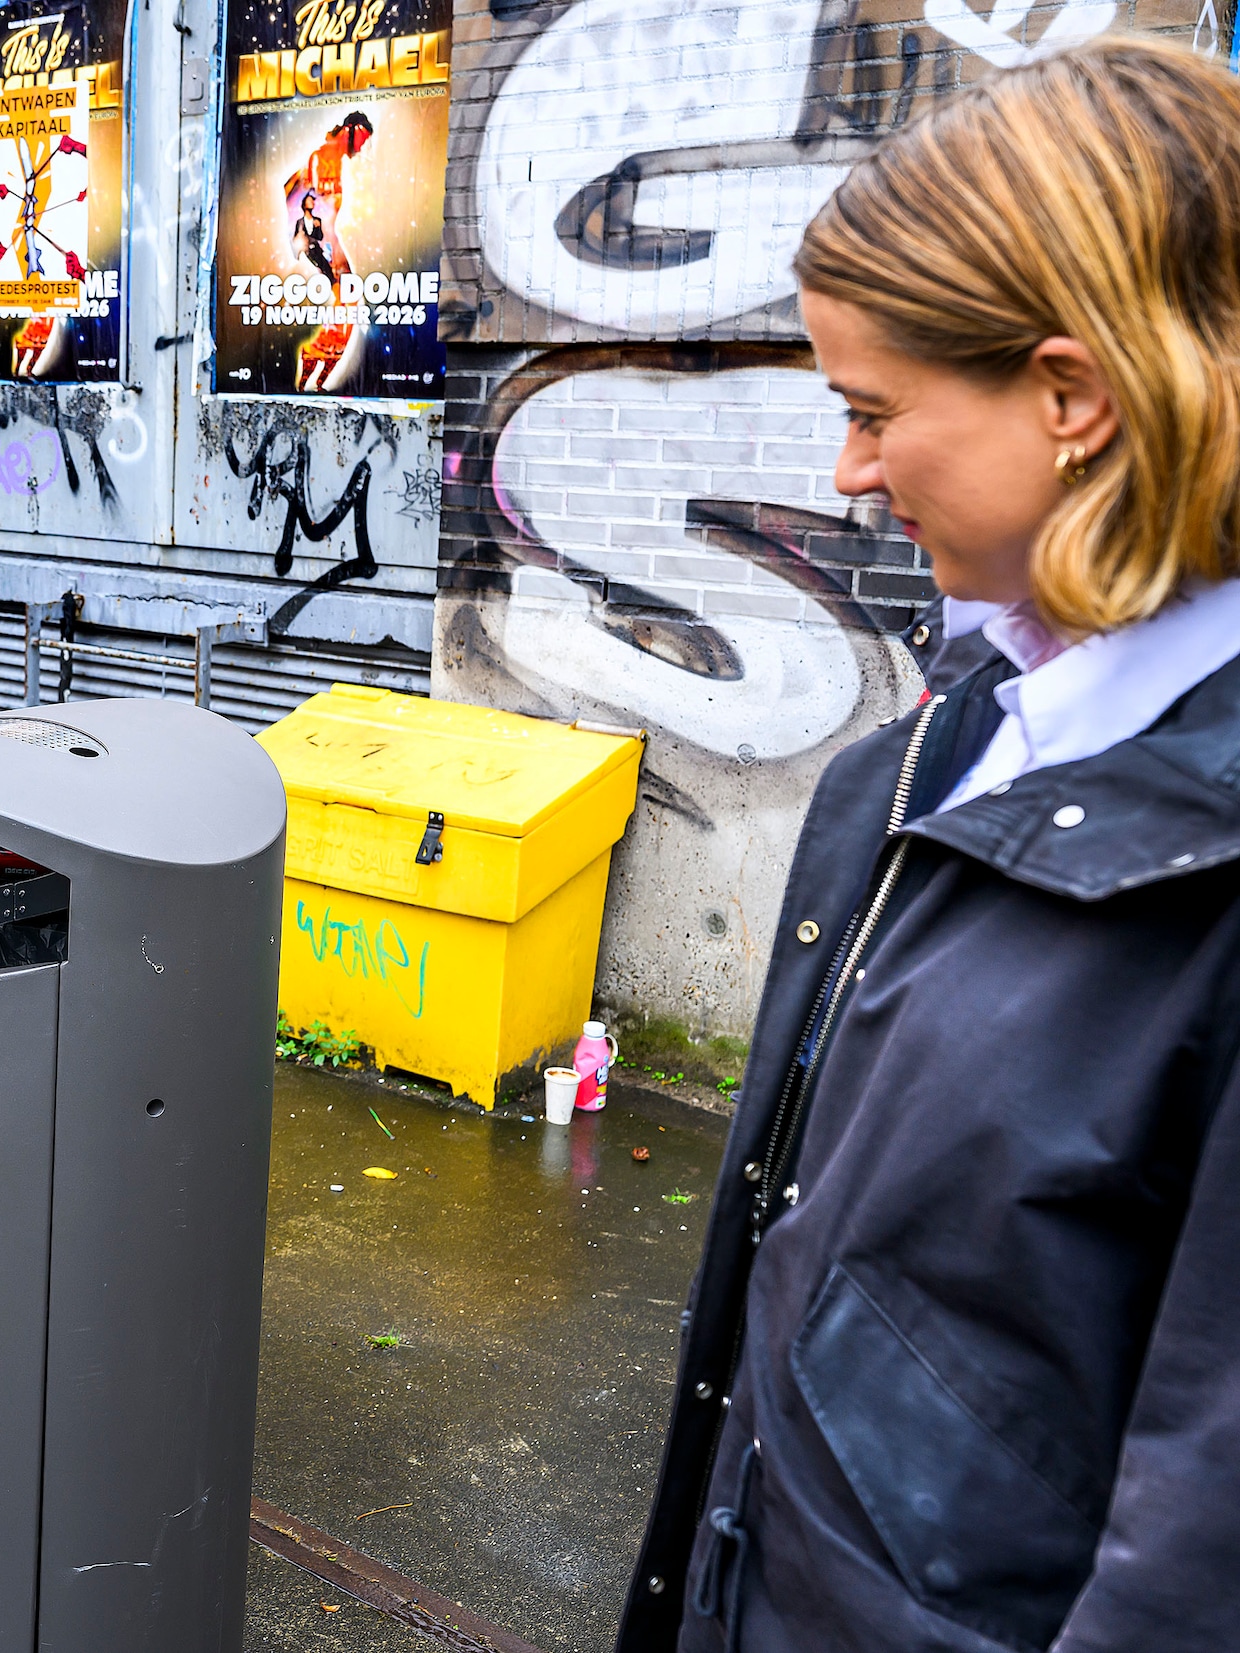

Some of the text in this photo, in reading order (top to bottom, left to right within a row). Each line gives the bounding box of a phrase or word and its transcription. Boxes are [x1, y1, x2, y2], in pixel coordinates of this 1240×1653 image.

[295, 0, 356, 50] This
[1, 24, 49, 78] This
[237, 32, 449, 102] MICHAEL
[228, 271, 439, 306] ZIGGO DOME
[241, 304, 427, 325] 19 NOVEMBER 2026
[287, 835, 416, 881] GRIT SALT
